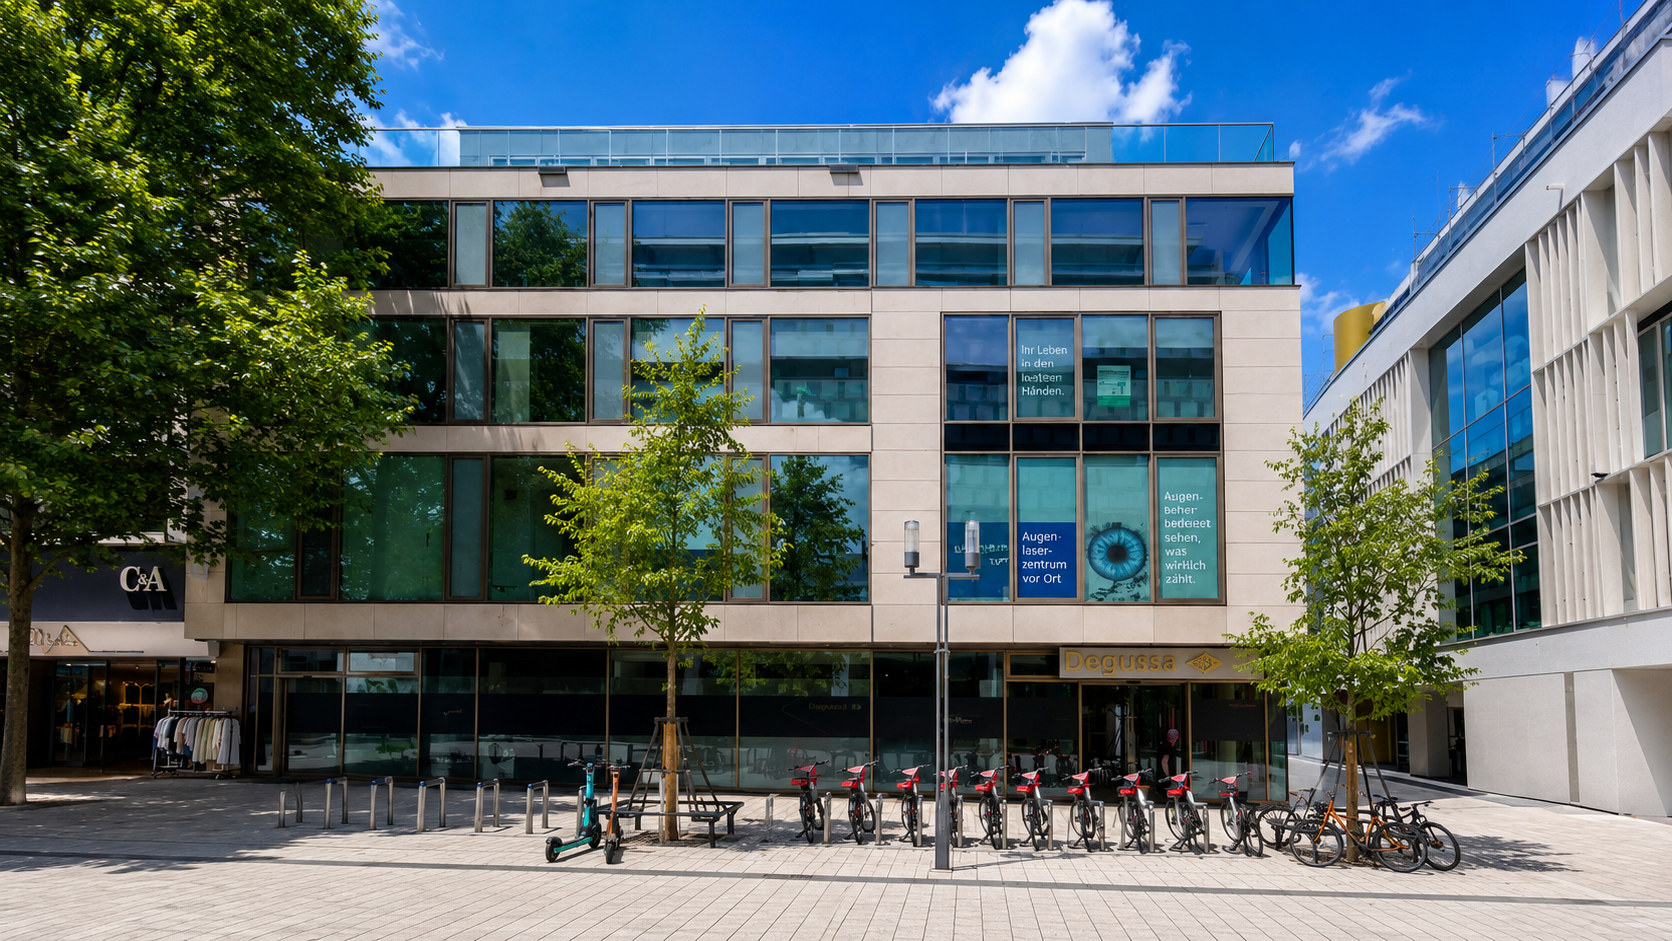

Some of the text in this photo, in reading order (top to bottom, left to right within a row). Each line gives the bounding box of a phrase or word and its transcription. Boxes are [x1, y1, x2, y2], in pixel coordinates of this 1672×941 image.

[1037, 344, 1068, 355] Leben
[1021, 358, 1054, 368] in den
[1022, 531, 1062, 544] Augen-
[1164, 532, 1201, 544] sehen,
[1022, 544, 1053, 556] laser-
[1164, 547, 1188, 556] was
[1022, 560, 1067, 570] zentrum
[119, 565, 168, 592] C&A
[1022, 573, 1062, 584] vor Ort
[1064, 651, 1177, 676] Degussa
